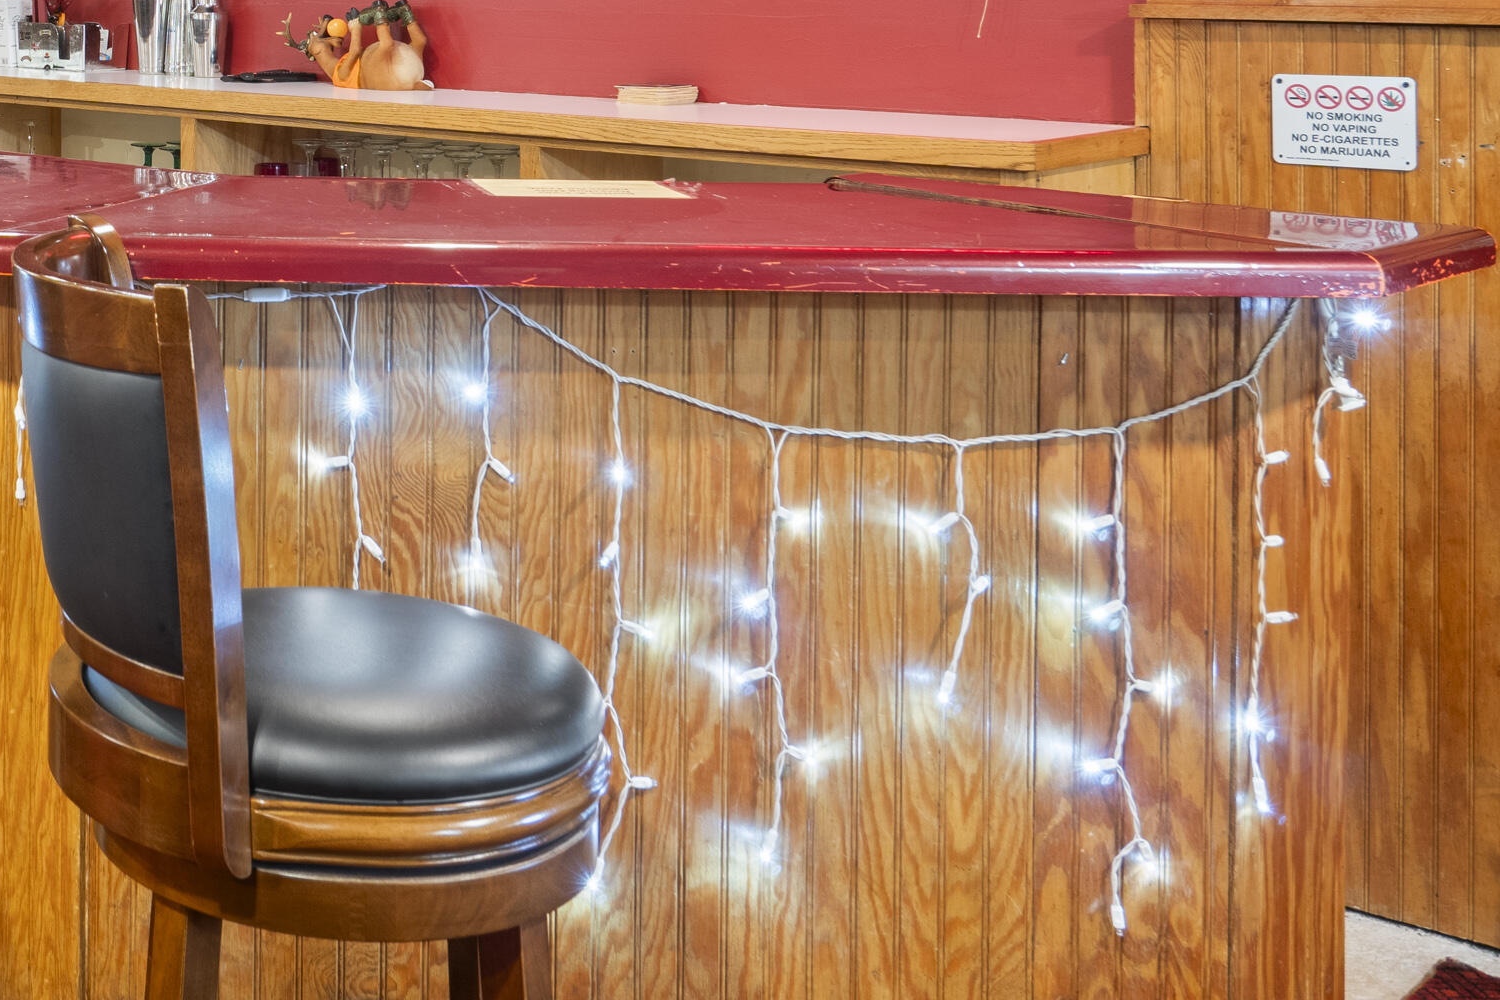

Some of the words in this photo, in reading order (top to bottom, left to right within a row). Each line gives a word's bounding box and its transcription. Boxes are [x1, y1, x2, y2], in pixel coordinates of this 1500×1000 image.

[1306, 111, 1324, 121] NO
[1326, 112, 1383, 123] SMOKING
[1312, 123, 1330, 132] NO
[1332, 124, 1377, 134] VAPING
[1291, 133, 1308, 143] NO
[1311, 134, 1399, 146] E-CIGARETTES
[1299, 145, 1317, 154] NO
[1320, 146, 1391, 158] MARIJUANA
